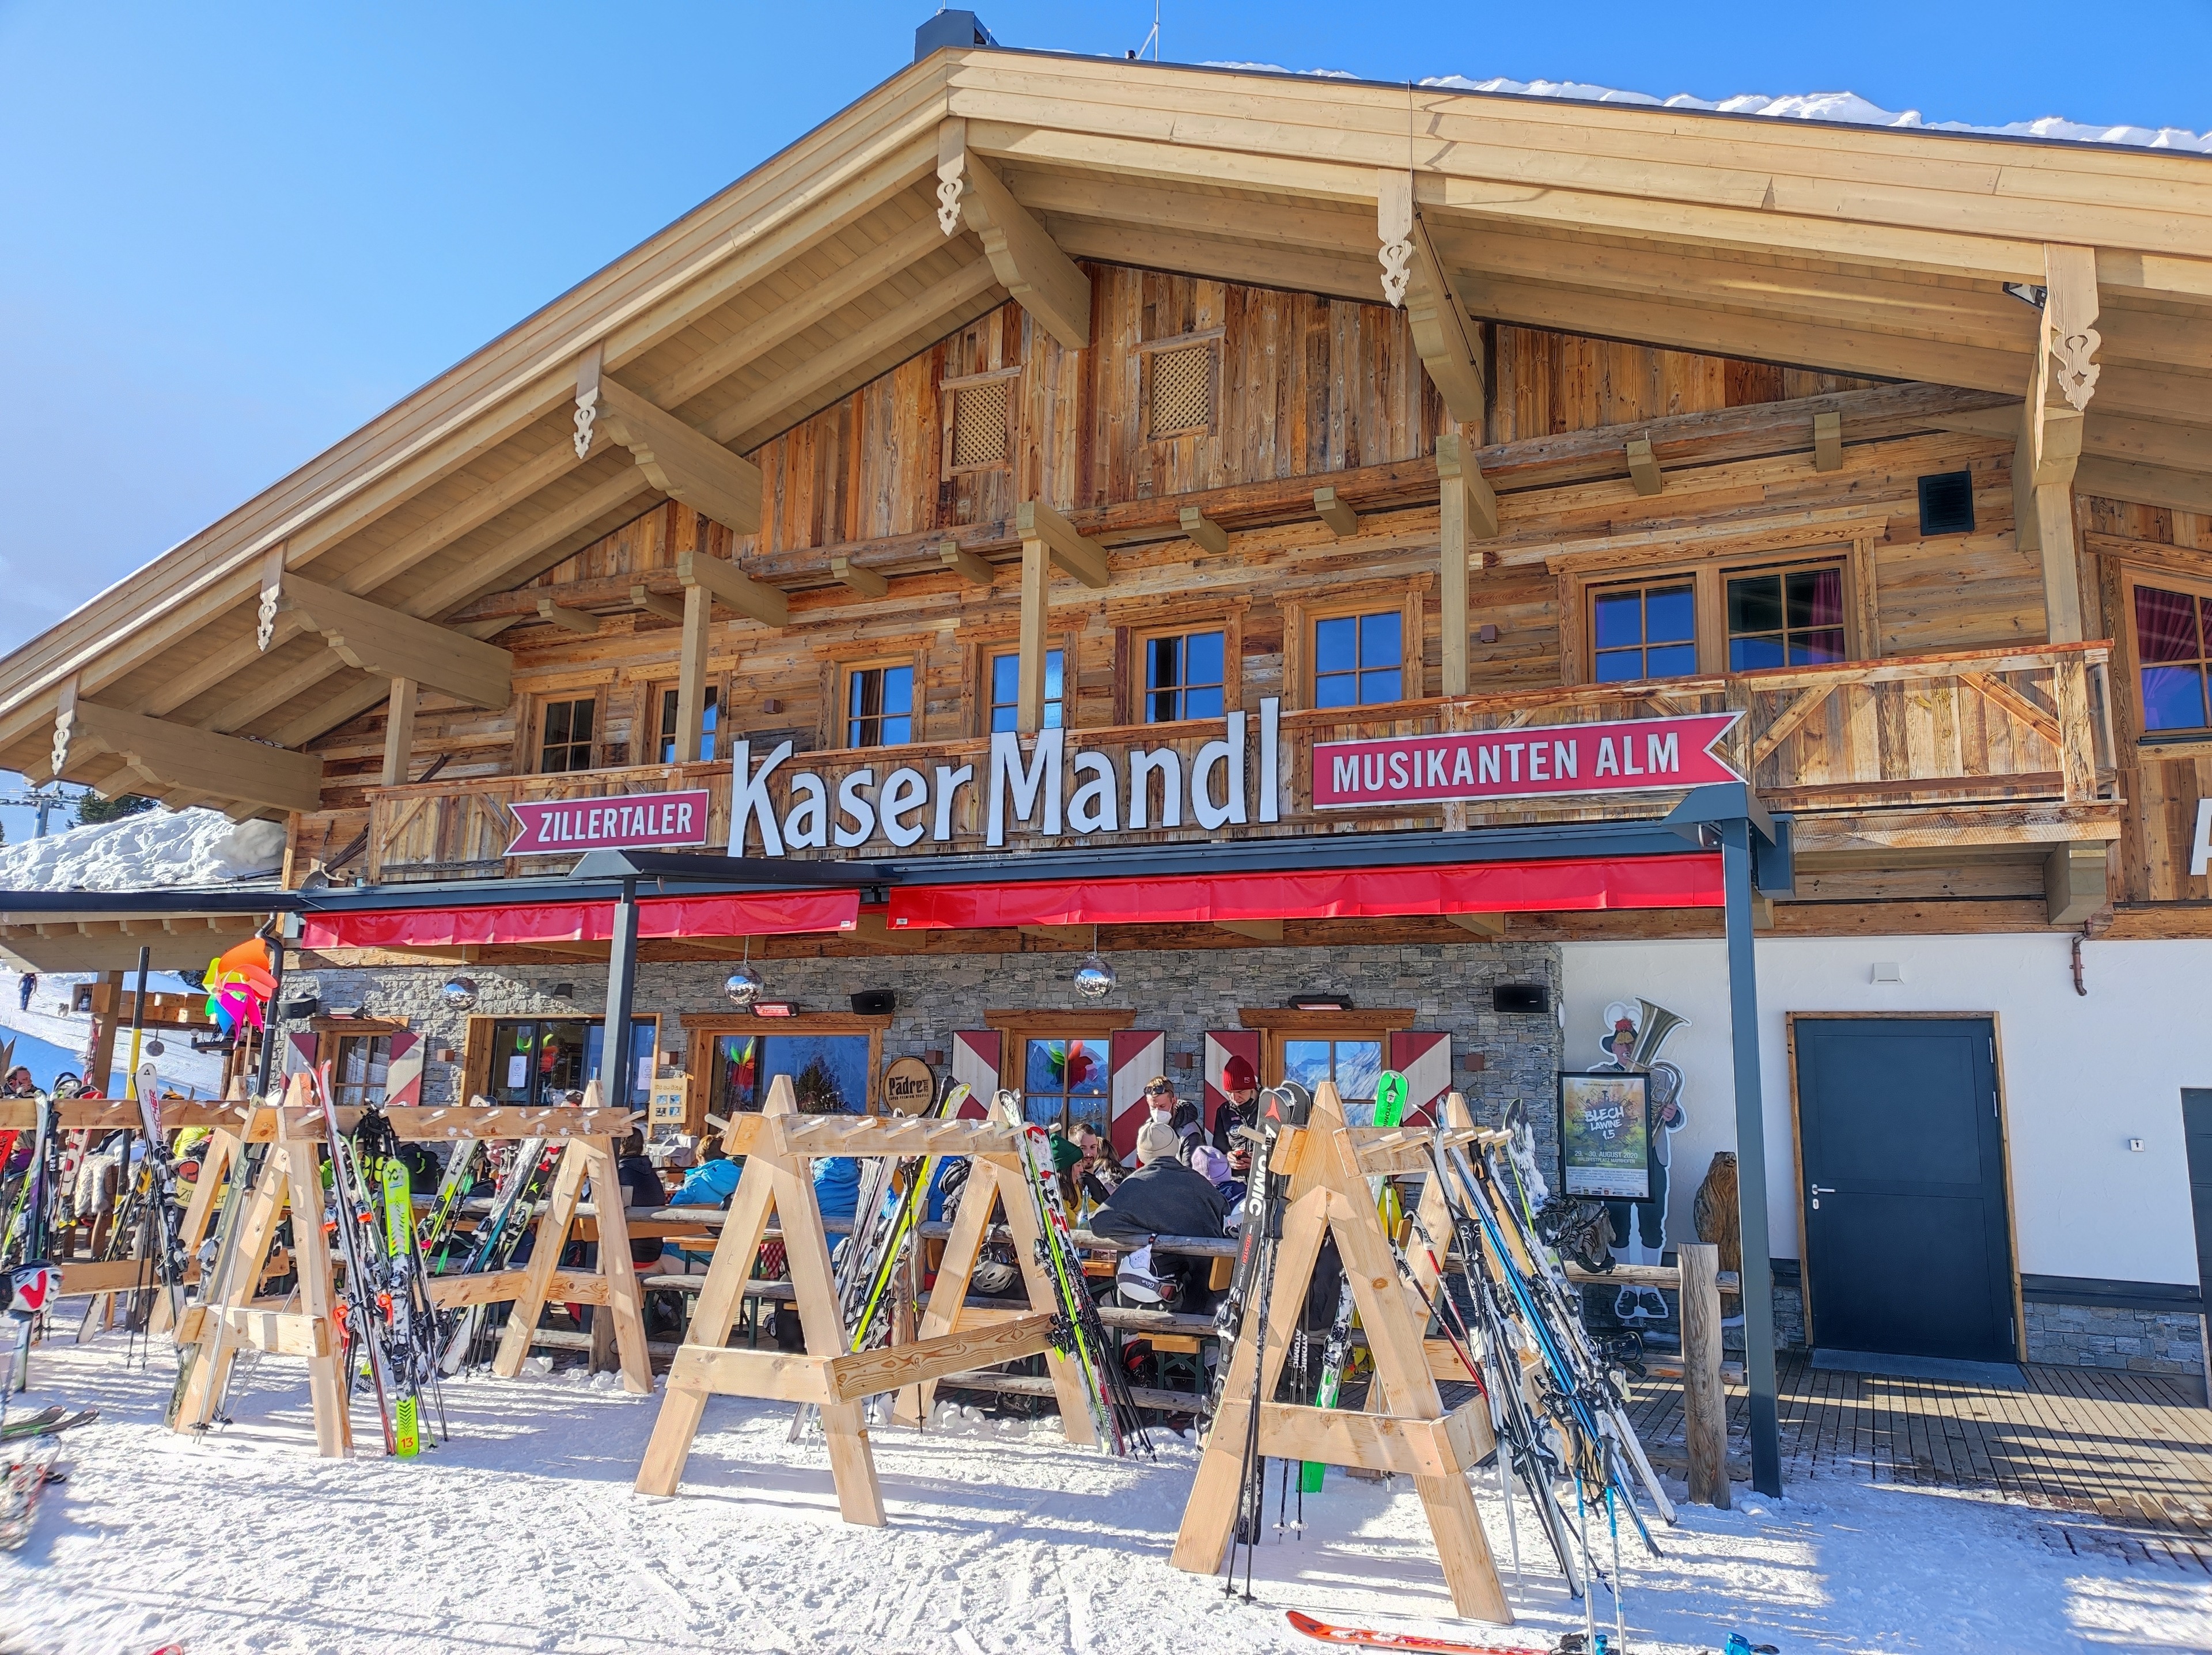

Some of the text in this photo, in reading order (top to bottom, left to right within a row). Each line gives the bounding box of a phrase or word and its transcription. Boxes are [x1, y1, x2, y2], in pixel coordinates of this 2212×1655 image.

[1333, 732, 1679, 793] MUSIKANTEN ALM
[537, 802, 692, 843] ZILLERTALER
[889, 1076, 923, 1096] Padre
[149, 1089, 164, 1141] FISCHER
[1383, 1103, 1392, 1126] ATOMI
[1584, 1106, 1624, 1122] BLECH
[1590, 1119, 1623, 1131] LAWINE
[1603, 1130, 1615, 1140] 1.5
[1249, 1124, 1277, 1216] AOMIC
[1241, 1234, 1252, 1263] REDSTER
[1293, 1328, 1301, 1369] ATOMIC
[401, 1437, 414, 1448] 13
